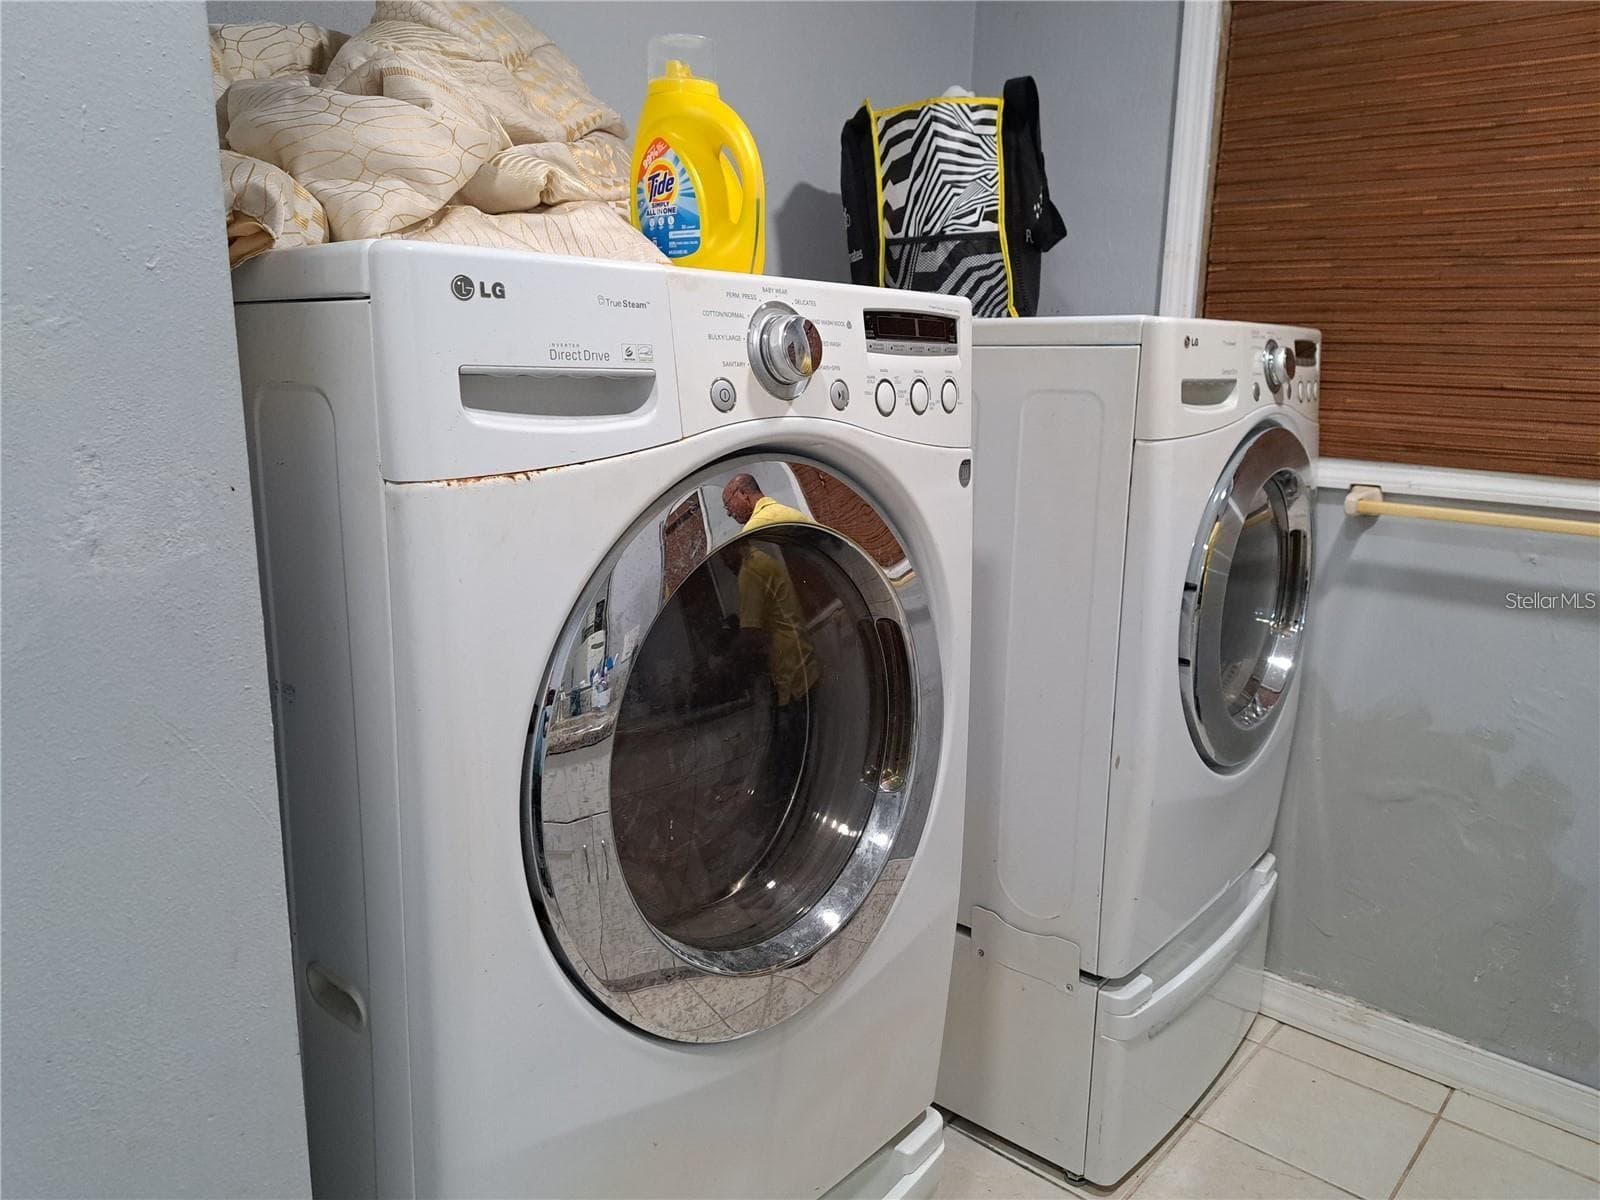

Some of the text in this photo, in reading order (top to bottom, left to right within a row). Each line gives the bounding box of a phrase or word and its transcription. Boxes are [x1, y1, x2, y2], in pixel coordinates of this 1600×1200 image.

[648, 172, 675, 202] Tide
[479, 281, 506, 299] LG
[742, 293, 757, 301] PRESS
[794, 298, 816, 306] DELICATES
